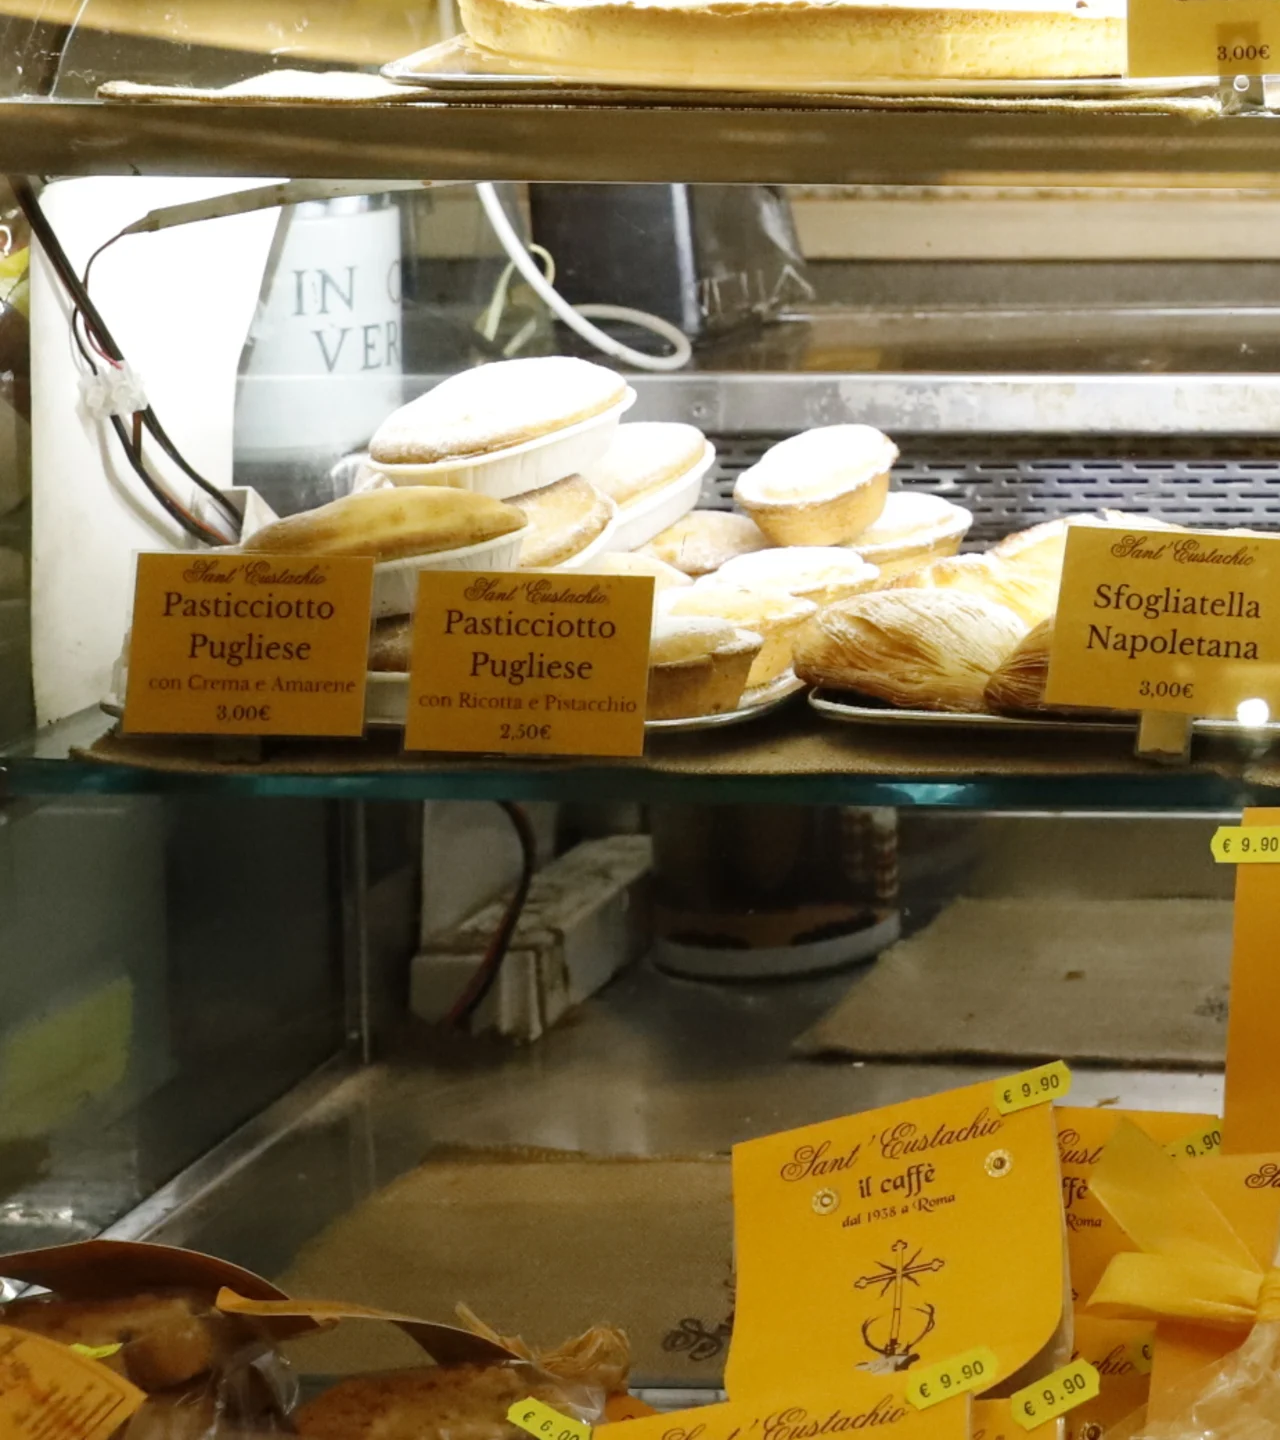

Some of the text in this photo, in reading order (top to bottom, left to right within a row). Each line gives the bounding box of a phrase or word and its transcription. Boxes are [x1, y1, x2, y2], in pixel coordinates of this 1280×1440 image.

[1216, 45, 1270, 63] 3,00€
[292, 265, 358, 316] IN
[162, 591, 334, 621] Pasticciotto
[1094, 584, 1261, 620] Sfogliatella
[445, 610, 616, 639] Pasticciotto
[187, 633, 311, 666] Pugliese
[1086, 624, 1259, 660] Napoletana
[469, 651, 593, 686] Pugliese
[149, 677, 181, 692] con
[188, 675, 249, 694] Crema
[1139, 680, 1194, 699] 3,00€
[217, 703, 270, 722] 3,00€
[419, 694, 452, 709] con
[545, 693, 637, 714] Pistacchio
[500, 723, 552, 742] 2,50€
[1241, 836, 1280, 852] 9.90
[1021, 1073, 1061, 1100] 9.90
[857, 1162, 937, 1199] il caffè
[841, 1210, 861, 1228] dal
[914, 1191, 957, 1215] Roma
[941, 1359, 987, 1392] 9.90
[1042, 1371, 1088, 1408] 9.90
